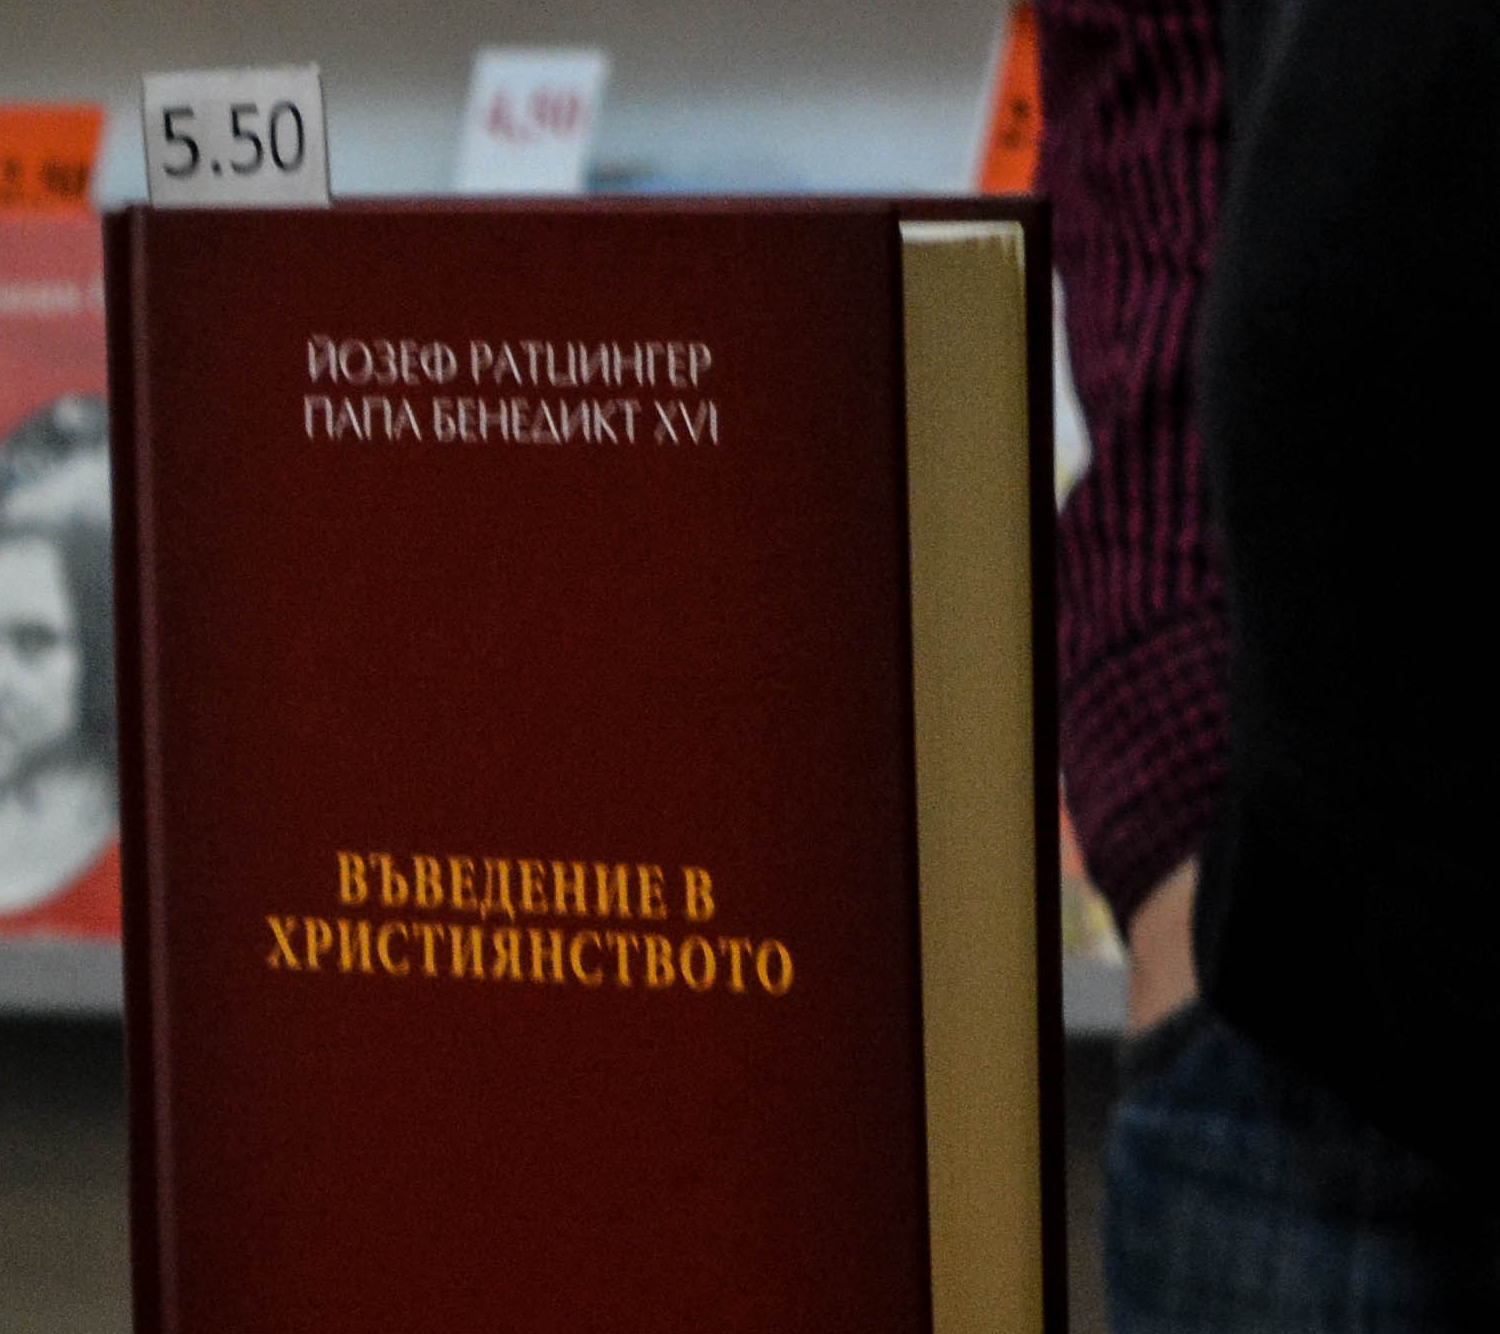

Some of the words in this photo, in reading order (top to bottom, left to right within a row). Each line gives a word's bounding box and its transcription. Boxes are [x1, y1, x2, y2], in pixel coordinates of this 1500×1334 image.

[161, 99, 307, 179] 5.50
[306, 334, 458, 387] ЙОЗЕФ
[470, 339, 714, 390] РАТЦИНГЕР
[304, 395, 423, 444] ПАПА
[433, 396, 643, 446] БЕНЕДИКТ
[335, 850, 668, 923] ВЪВЕДЕНИЕ
[683, 866, 717, 922] В
[264, 914, 795, 997] ХРИСТИЯНСТВОТО
